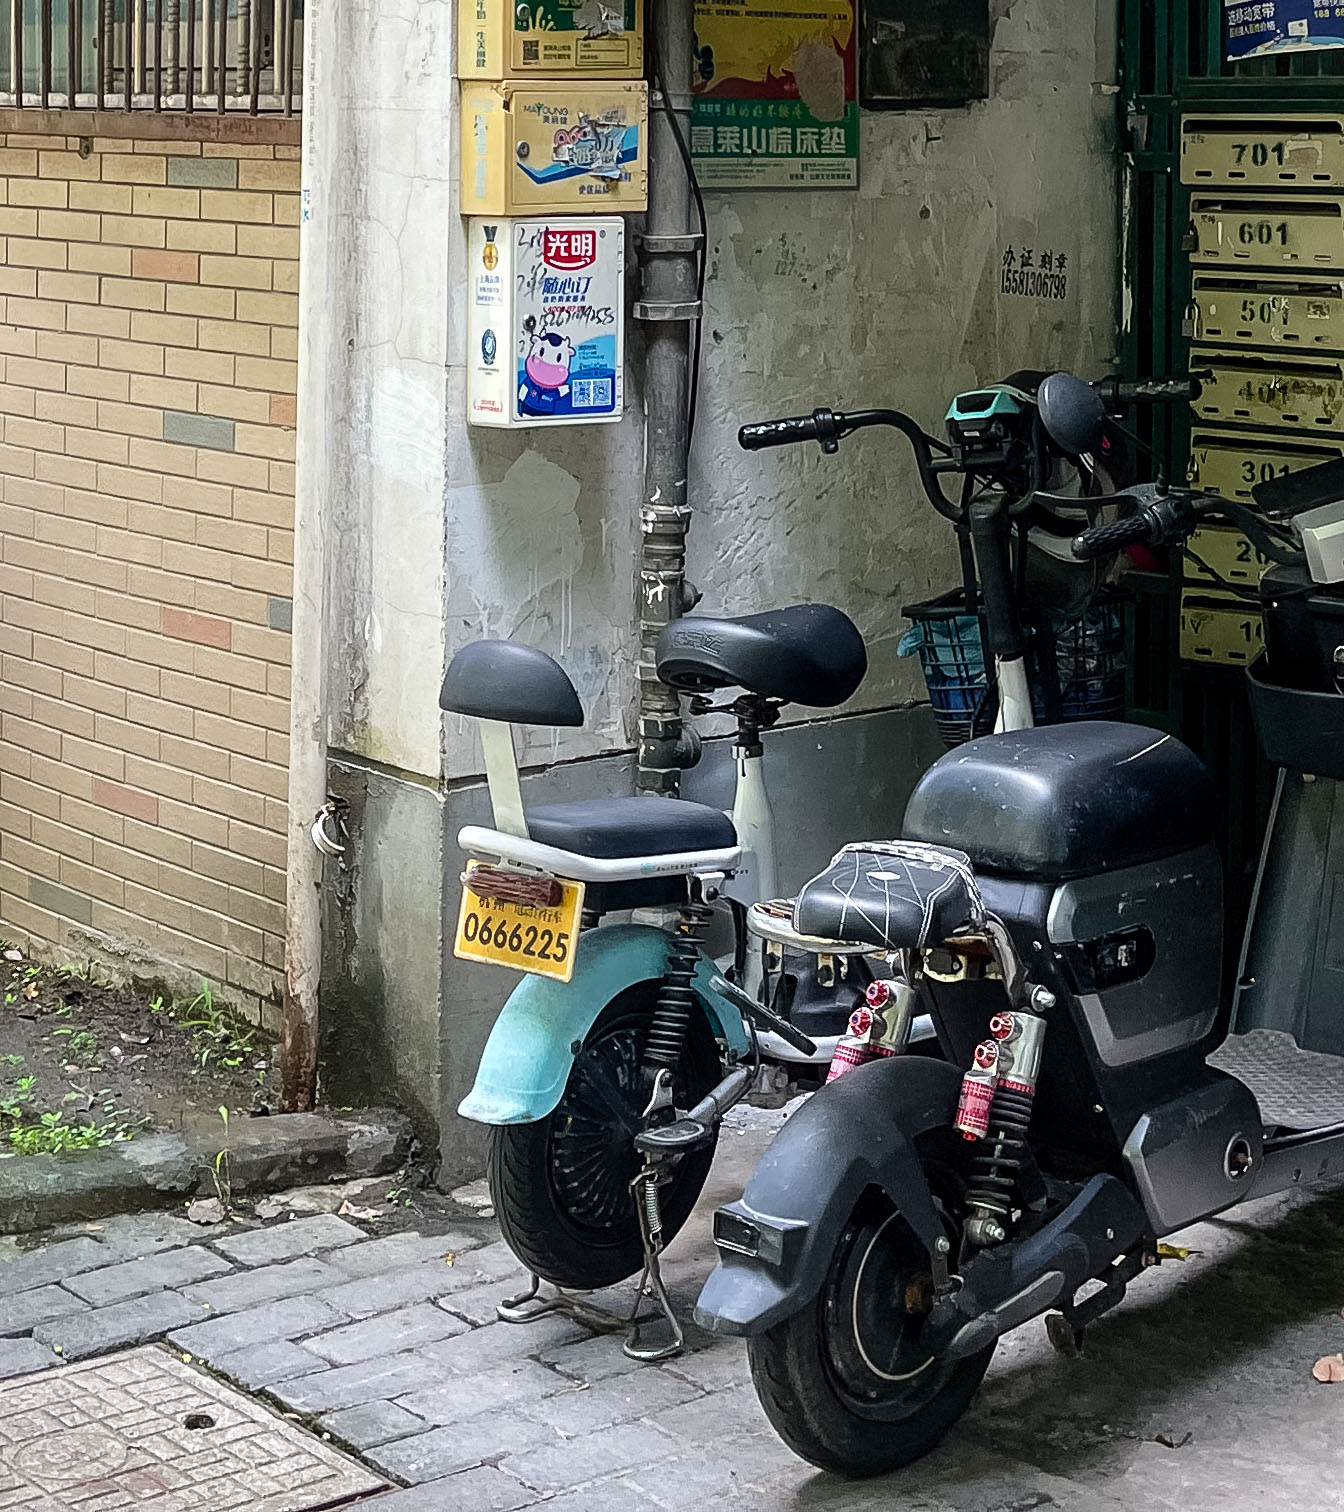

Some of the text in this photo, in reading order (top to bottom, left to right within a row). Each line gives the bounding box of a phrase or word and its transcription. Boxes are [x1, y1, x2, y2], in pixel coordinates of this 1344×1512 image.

[1231, 141, 1286, 167] 701
[547, 232, 593, 257] 光明
[1238, 221, 1289, 247] 601
[1001, 269, 1067, 300] 15581306798
[464, 912, 569, 962] 0666225
